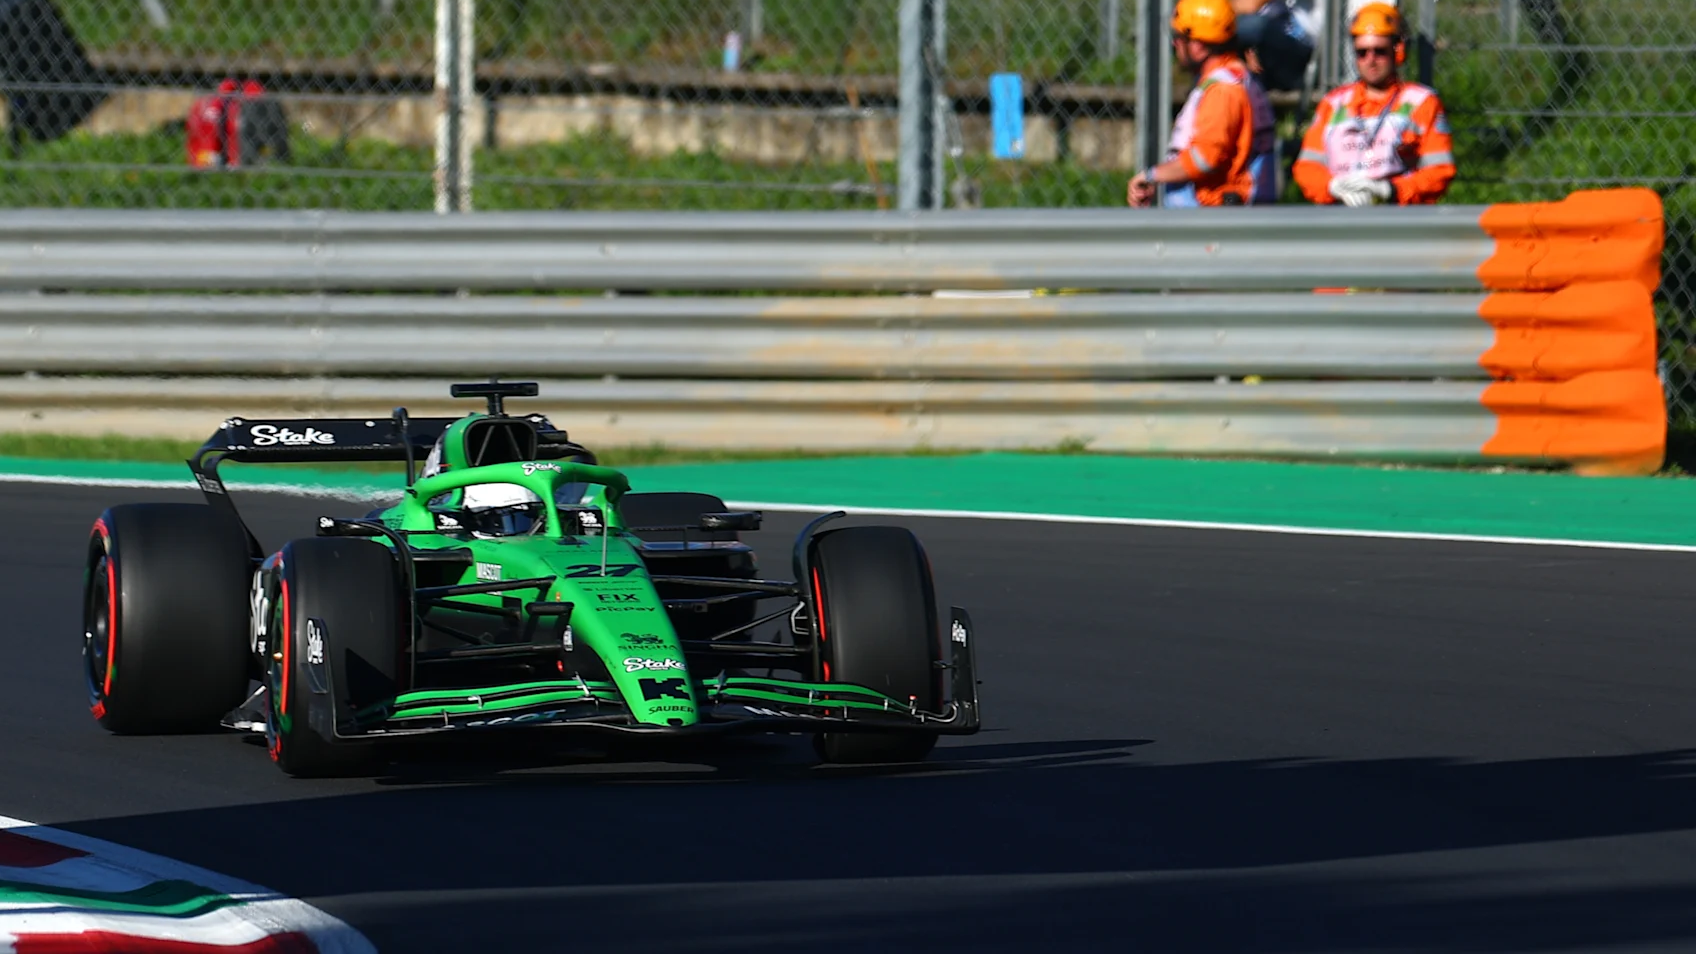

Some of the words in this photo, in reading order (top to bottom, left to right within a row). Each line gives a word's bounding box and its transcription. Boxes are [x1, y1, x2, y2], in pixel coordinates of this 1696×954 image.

[250, 424, 336, 446] Stake
[521, 462, 562, 476] Stake
[564, 564, 644, 578] 27
[596, 593, 639, 601] FIX
[623, 657, 687, 673] Stake
[648, 705, 694, 715] SAUBER
